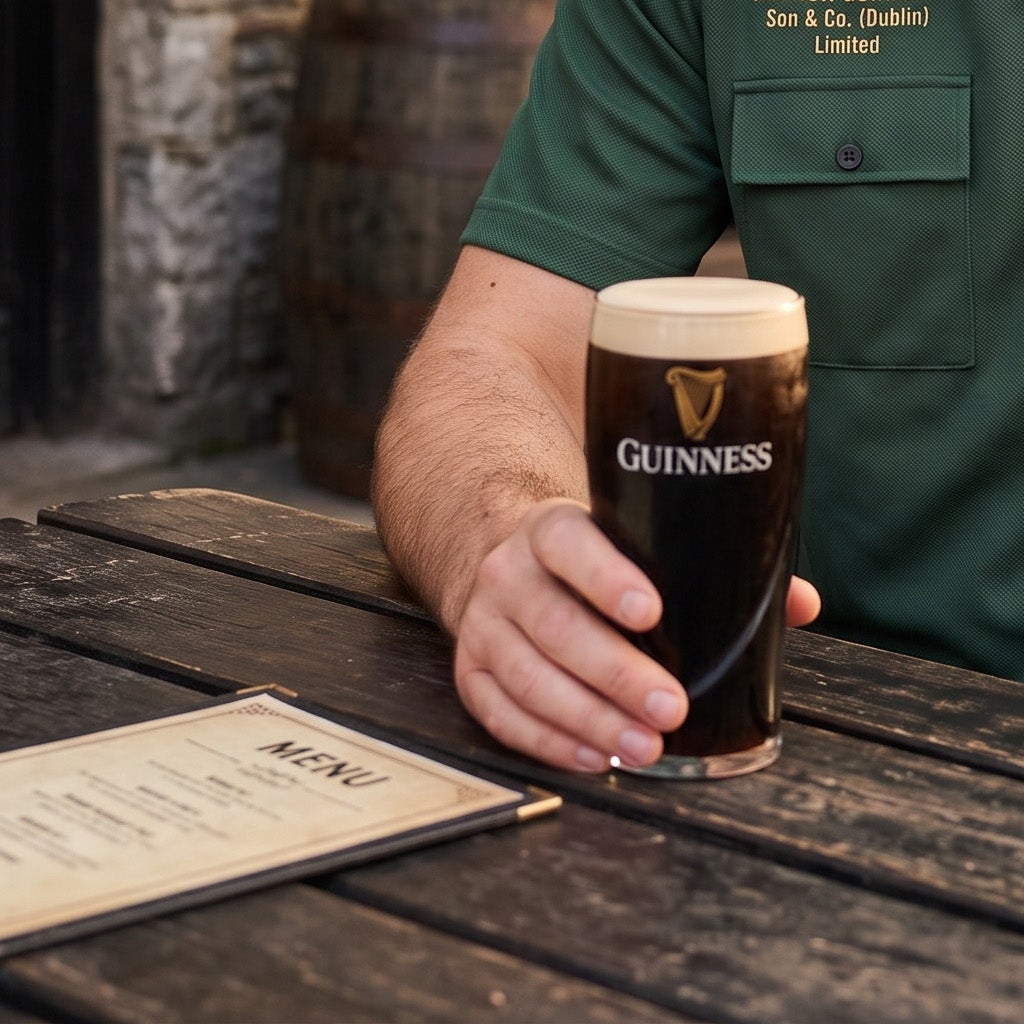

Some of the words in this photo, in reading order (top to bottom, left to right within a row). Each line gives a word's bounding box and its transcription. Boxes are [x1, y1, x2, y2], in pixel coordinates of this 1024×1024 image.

[766, 8, 798, 28] Son
[805, 8, 818, 28] &
[824, 8, 851, 28] Co.
[860, 6, 929, 29] (Dublin)
[815, 35, 880, 54] Limited
[616, 437, 773, 476] GUINNESS
[256, 740, 393, 788] MENU
